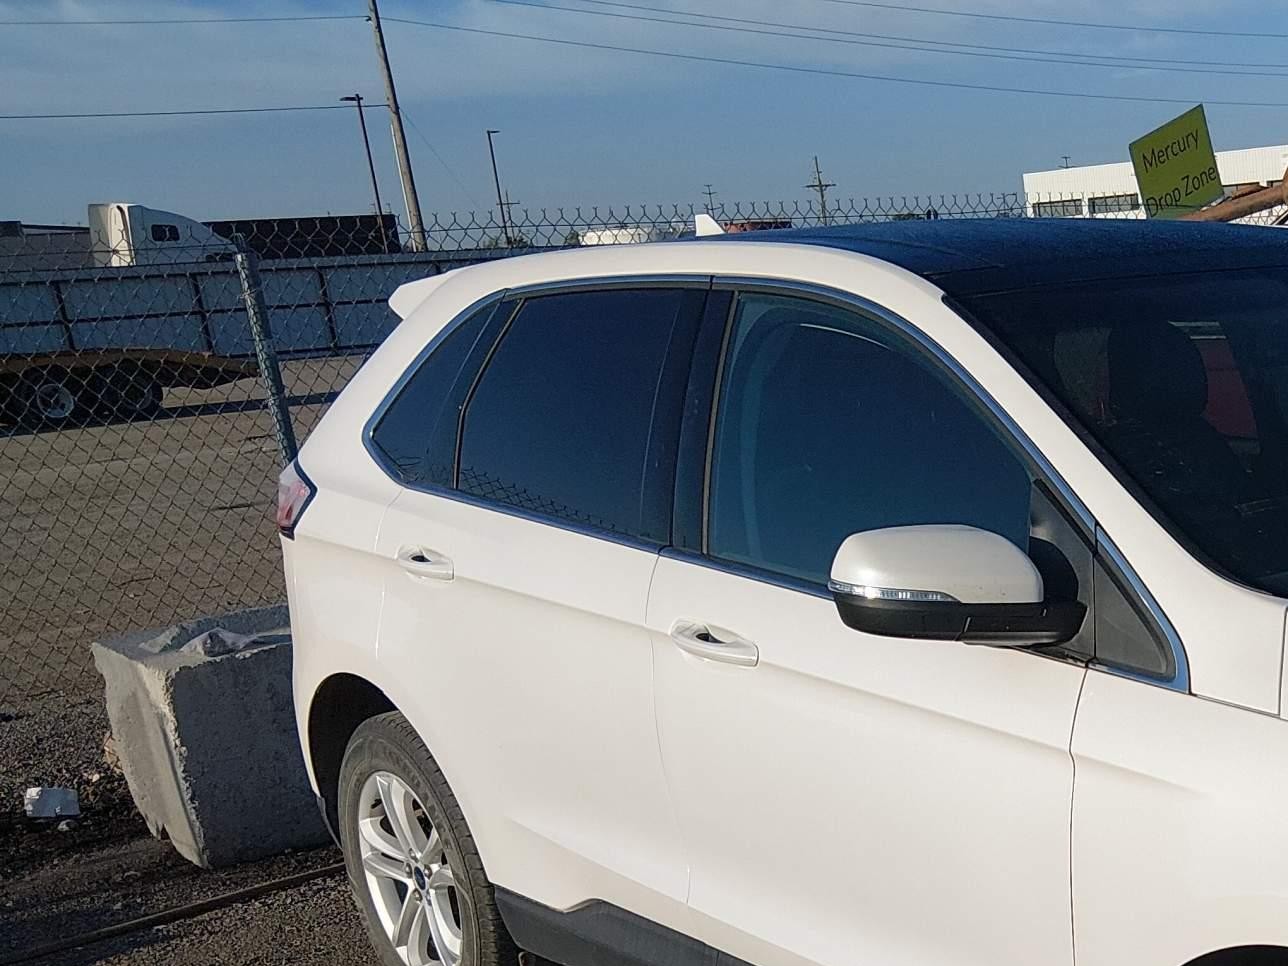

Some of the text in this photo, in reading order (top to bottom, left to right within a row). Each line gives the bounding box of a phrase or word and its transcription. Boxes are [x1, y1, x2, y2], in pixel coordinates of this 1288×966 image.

[1142, 129, 1199, 174] Mercury
[1145, 166, 1217, 218] Drop Zone
